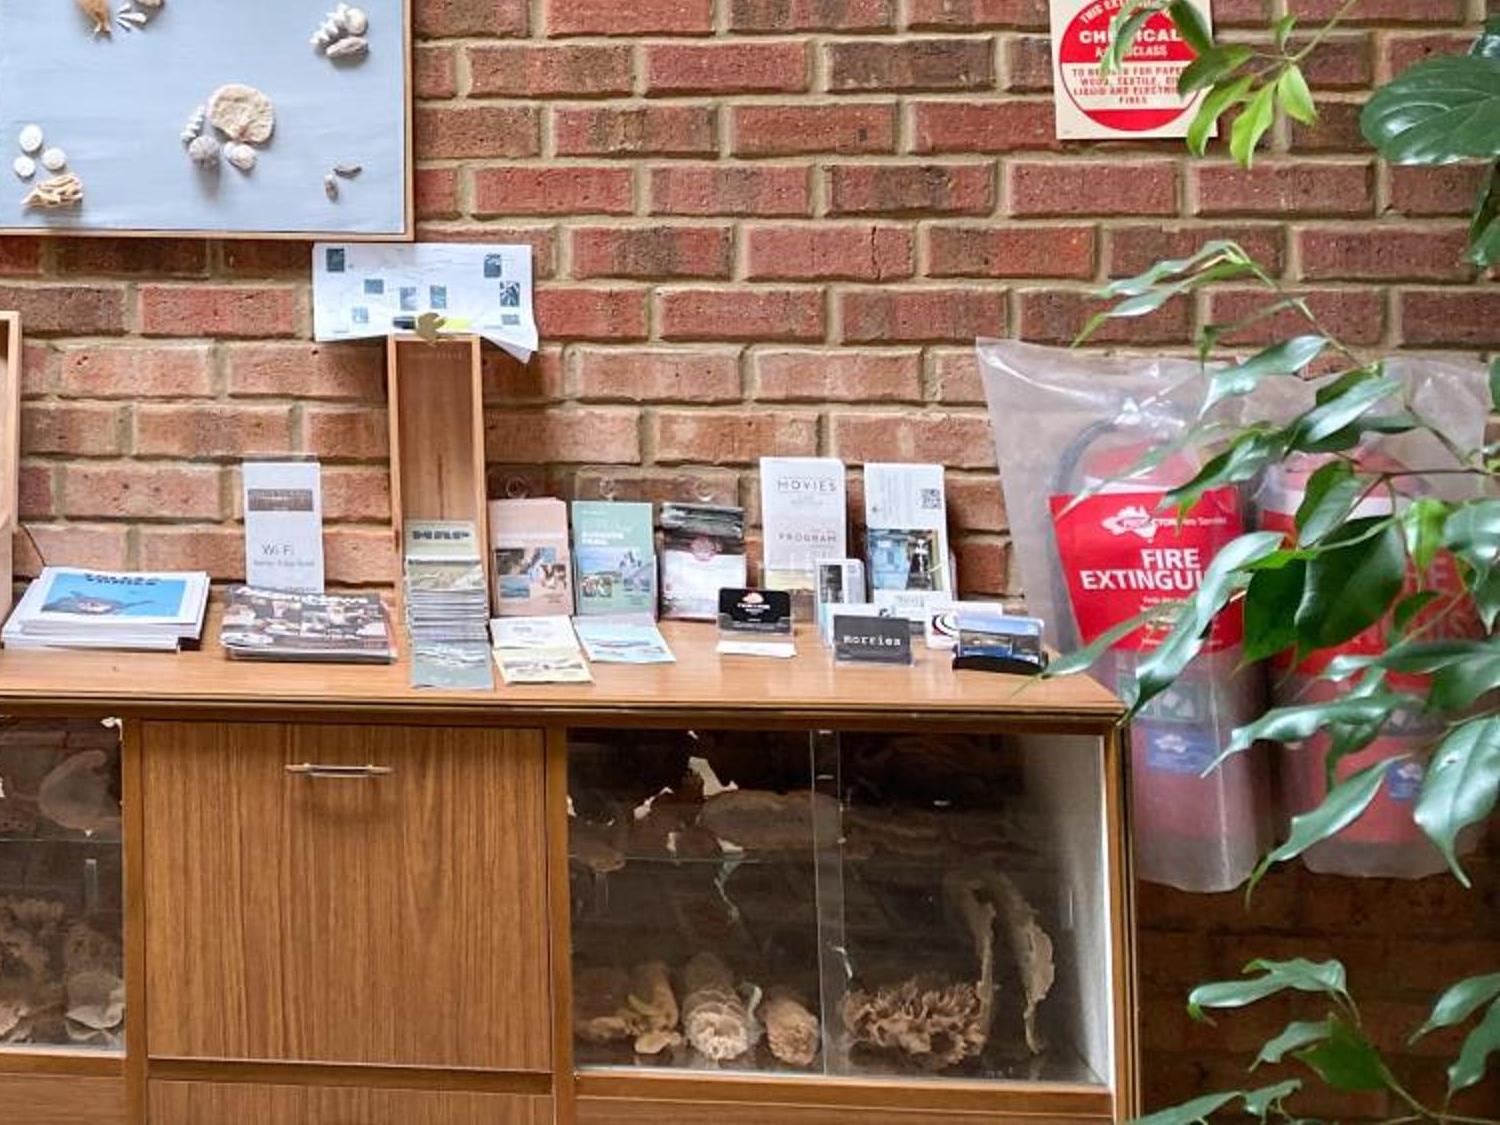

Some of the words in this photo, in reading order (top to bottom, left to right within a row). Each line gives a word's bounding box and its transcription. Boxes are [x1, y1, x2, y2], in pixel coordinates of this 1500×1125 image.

[1079, 28, 1183, 44] CHICAL
[777, 480, 837, 492] MOVIES
[1140, 548, 1200, 569] FIRE
[1079, 569, 1206, 590] EXTINGUI
